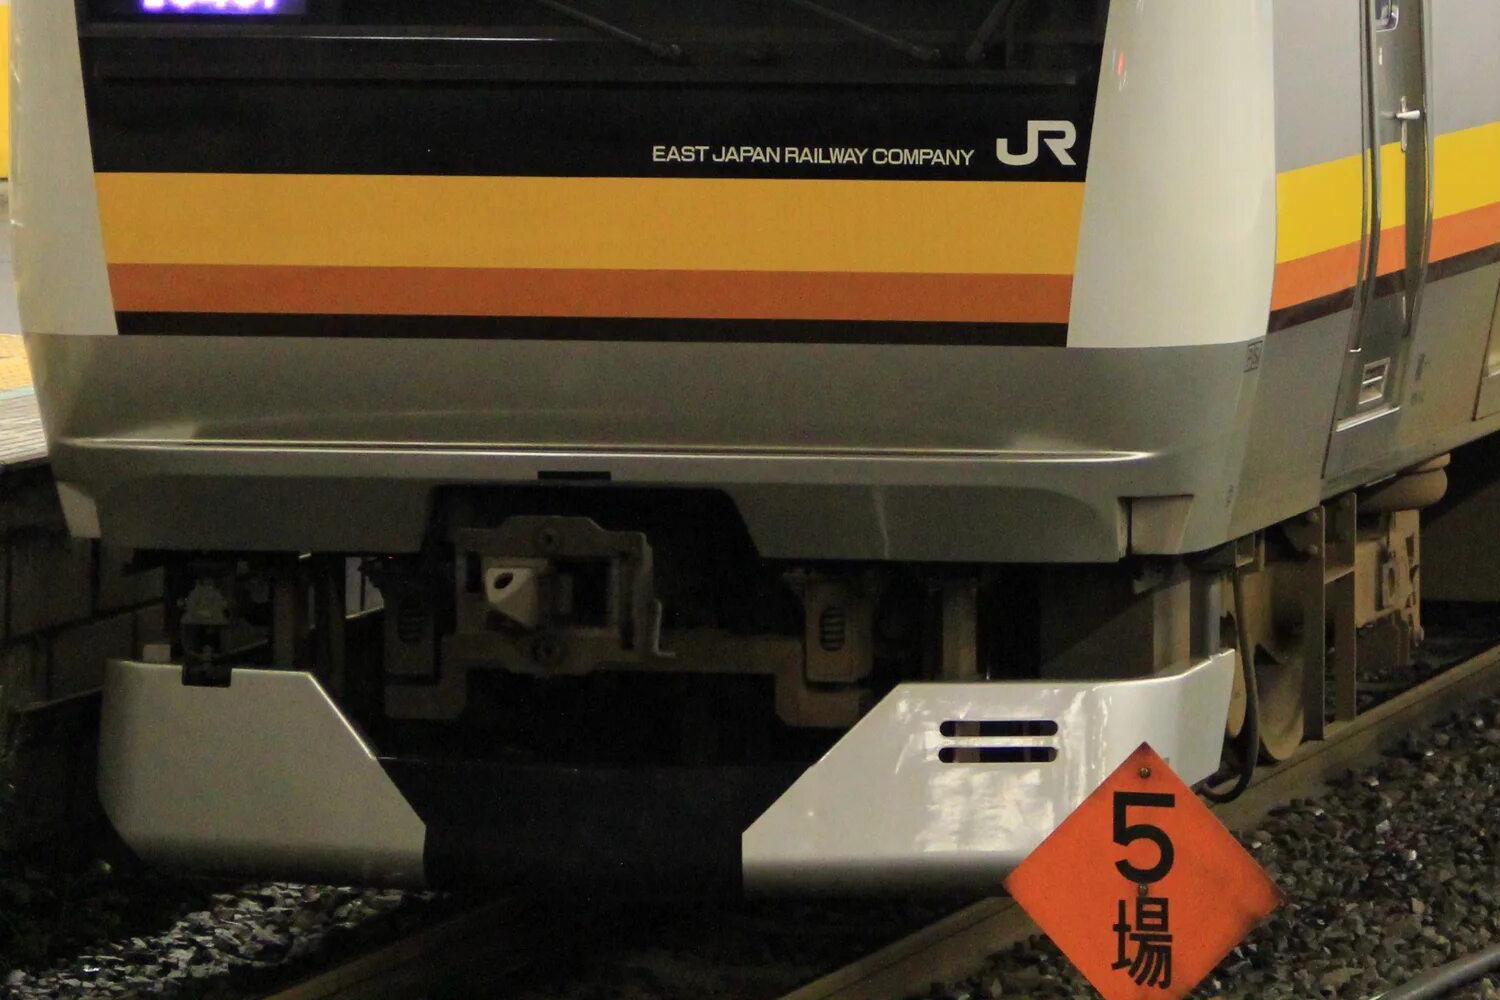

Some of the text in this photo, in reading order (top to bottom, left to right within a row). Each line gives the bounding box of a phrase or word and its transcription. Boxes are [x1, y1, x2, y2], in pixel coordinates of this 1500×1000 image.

[652, 145, 975, 166] EAST JAPAN RAILWAY COMPANY
[996, 119, 1077, 166] JR
